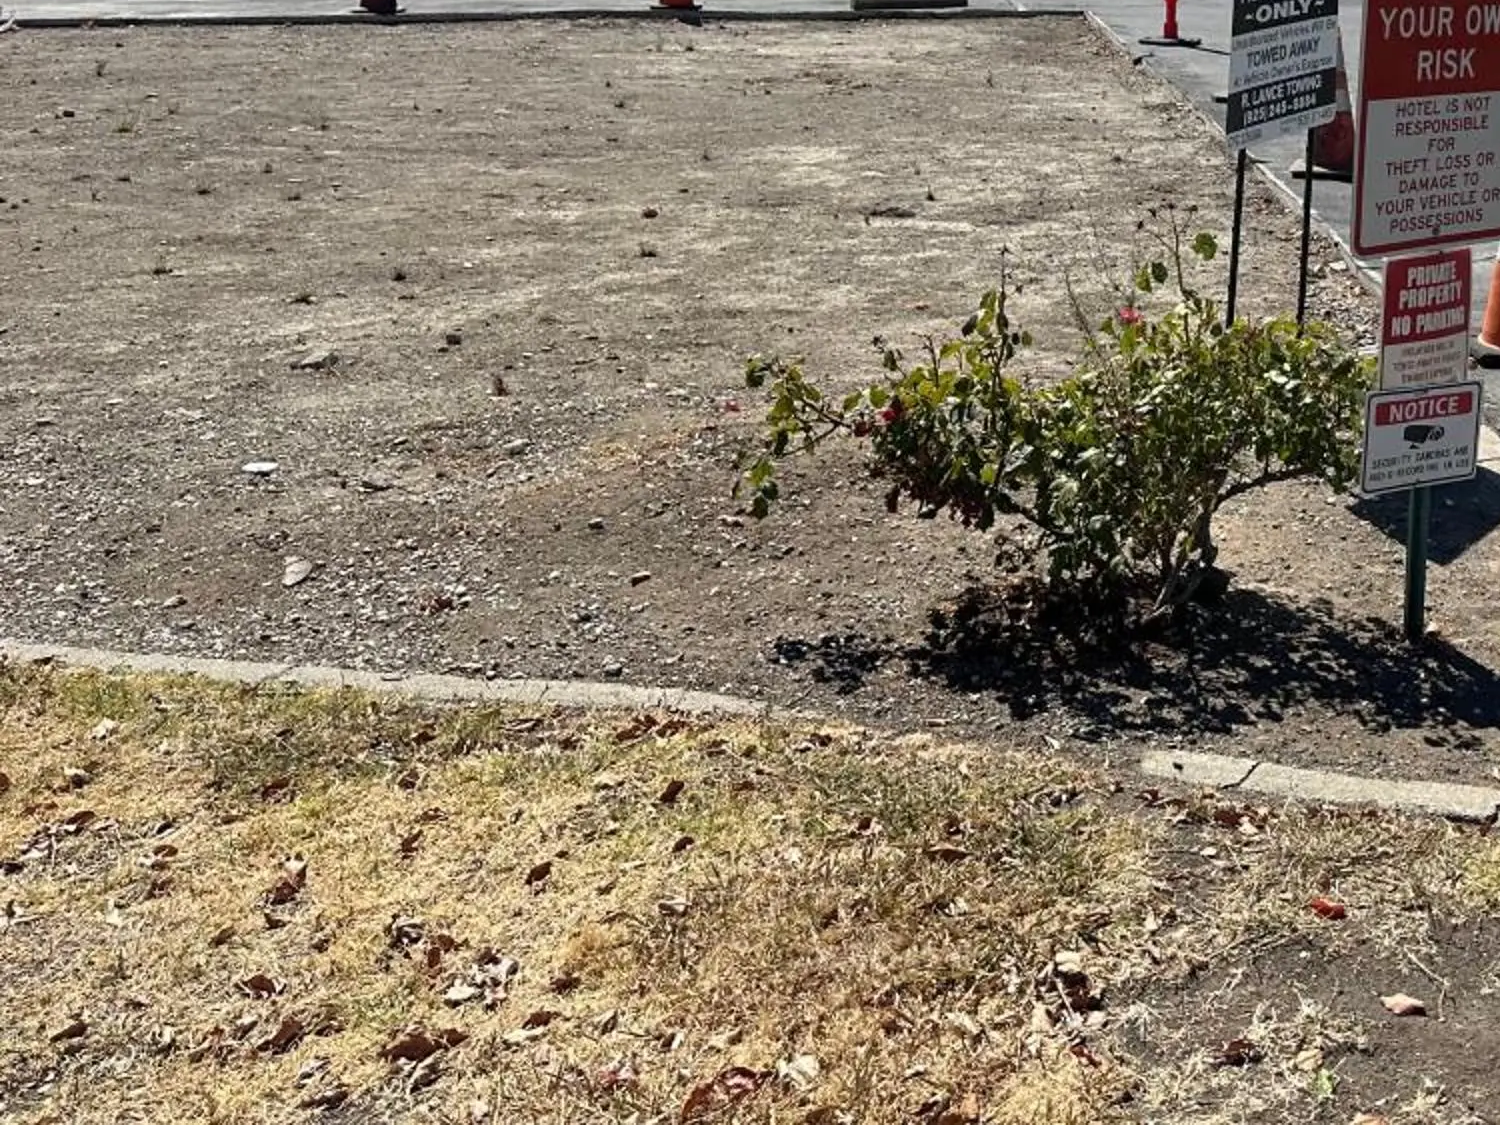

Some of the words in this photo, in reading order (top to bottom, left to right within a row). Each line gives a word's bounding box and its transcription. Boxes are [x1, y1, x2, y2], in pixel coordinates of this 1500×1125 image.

[1379, 6, 1454, 40] YOUR
[1247, 44, 1287, 68] TOWED
[1288, 36, 1320, 59] AWAY
[1417, 48, 1477, 83] RISK
[1395, 98, 1441, 118] HOTEL
[1445, 98, 1460, 114] IS
[1463, 96, 1491, 112] NOT
[1395, 115, 1489, 137] RESPONSIBLE
[1427, 136, 1455, 152] FOR
[1436, 154, 1471, 172] LOSS
[1475, 152, 1495, 167] OR
[1399, 174, 1457, 194] DAMAGE
[1463, 172, 1479, 187] TO
[1375, 198, 1414, 217] YOUR
[1419, 190, 1477, 211] VEHICLE
[1482, 188, 1500, 203] OR
[1389, 208, 1484, 234] POSSESSIONS
[1407, 260, 1457, 288] PRIVATE
[1399, 280, 1463, 310] PROPERTY
[1391, 315, 1412, 337] NO
[1416, 305, 1465, 334] PARKING
[1389, 395, 1460, 423] NOTICE
